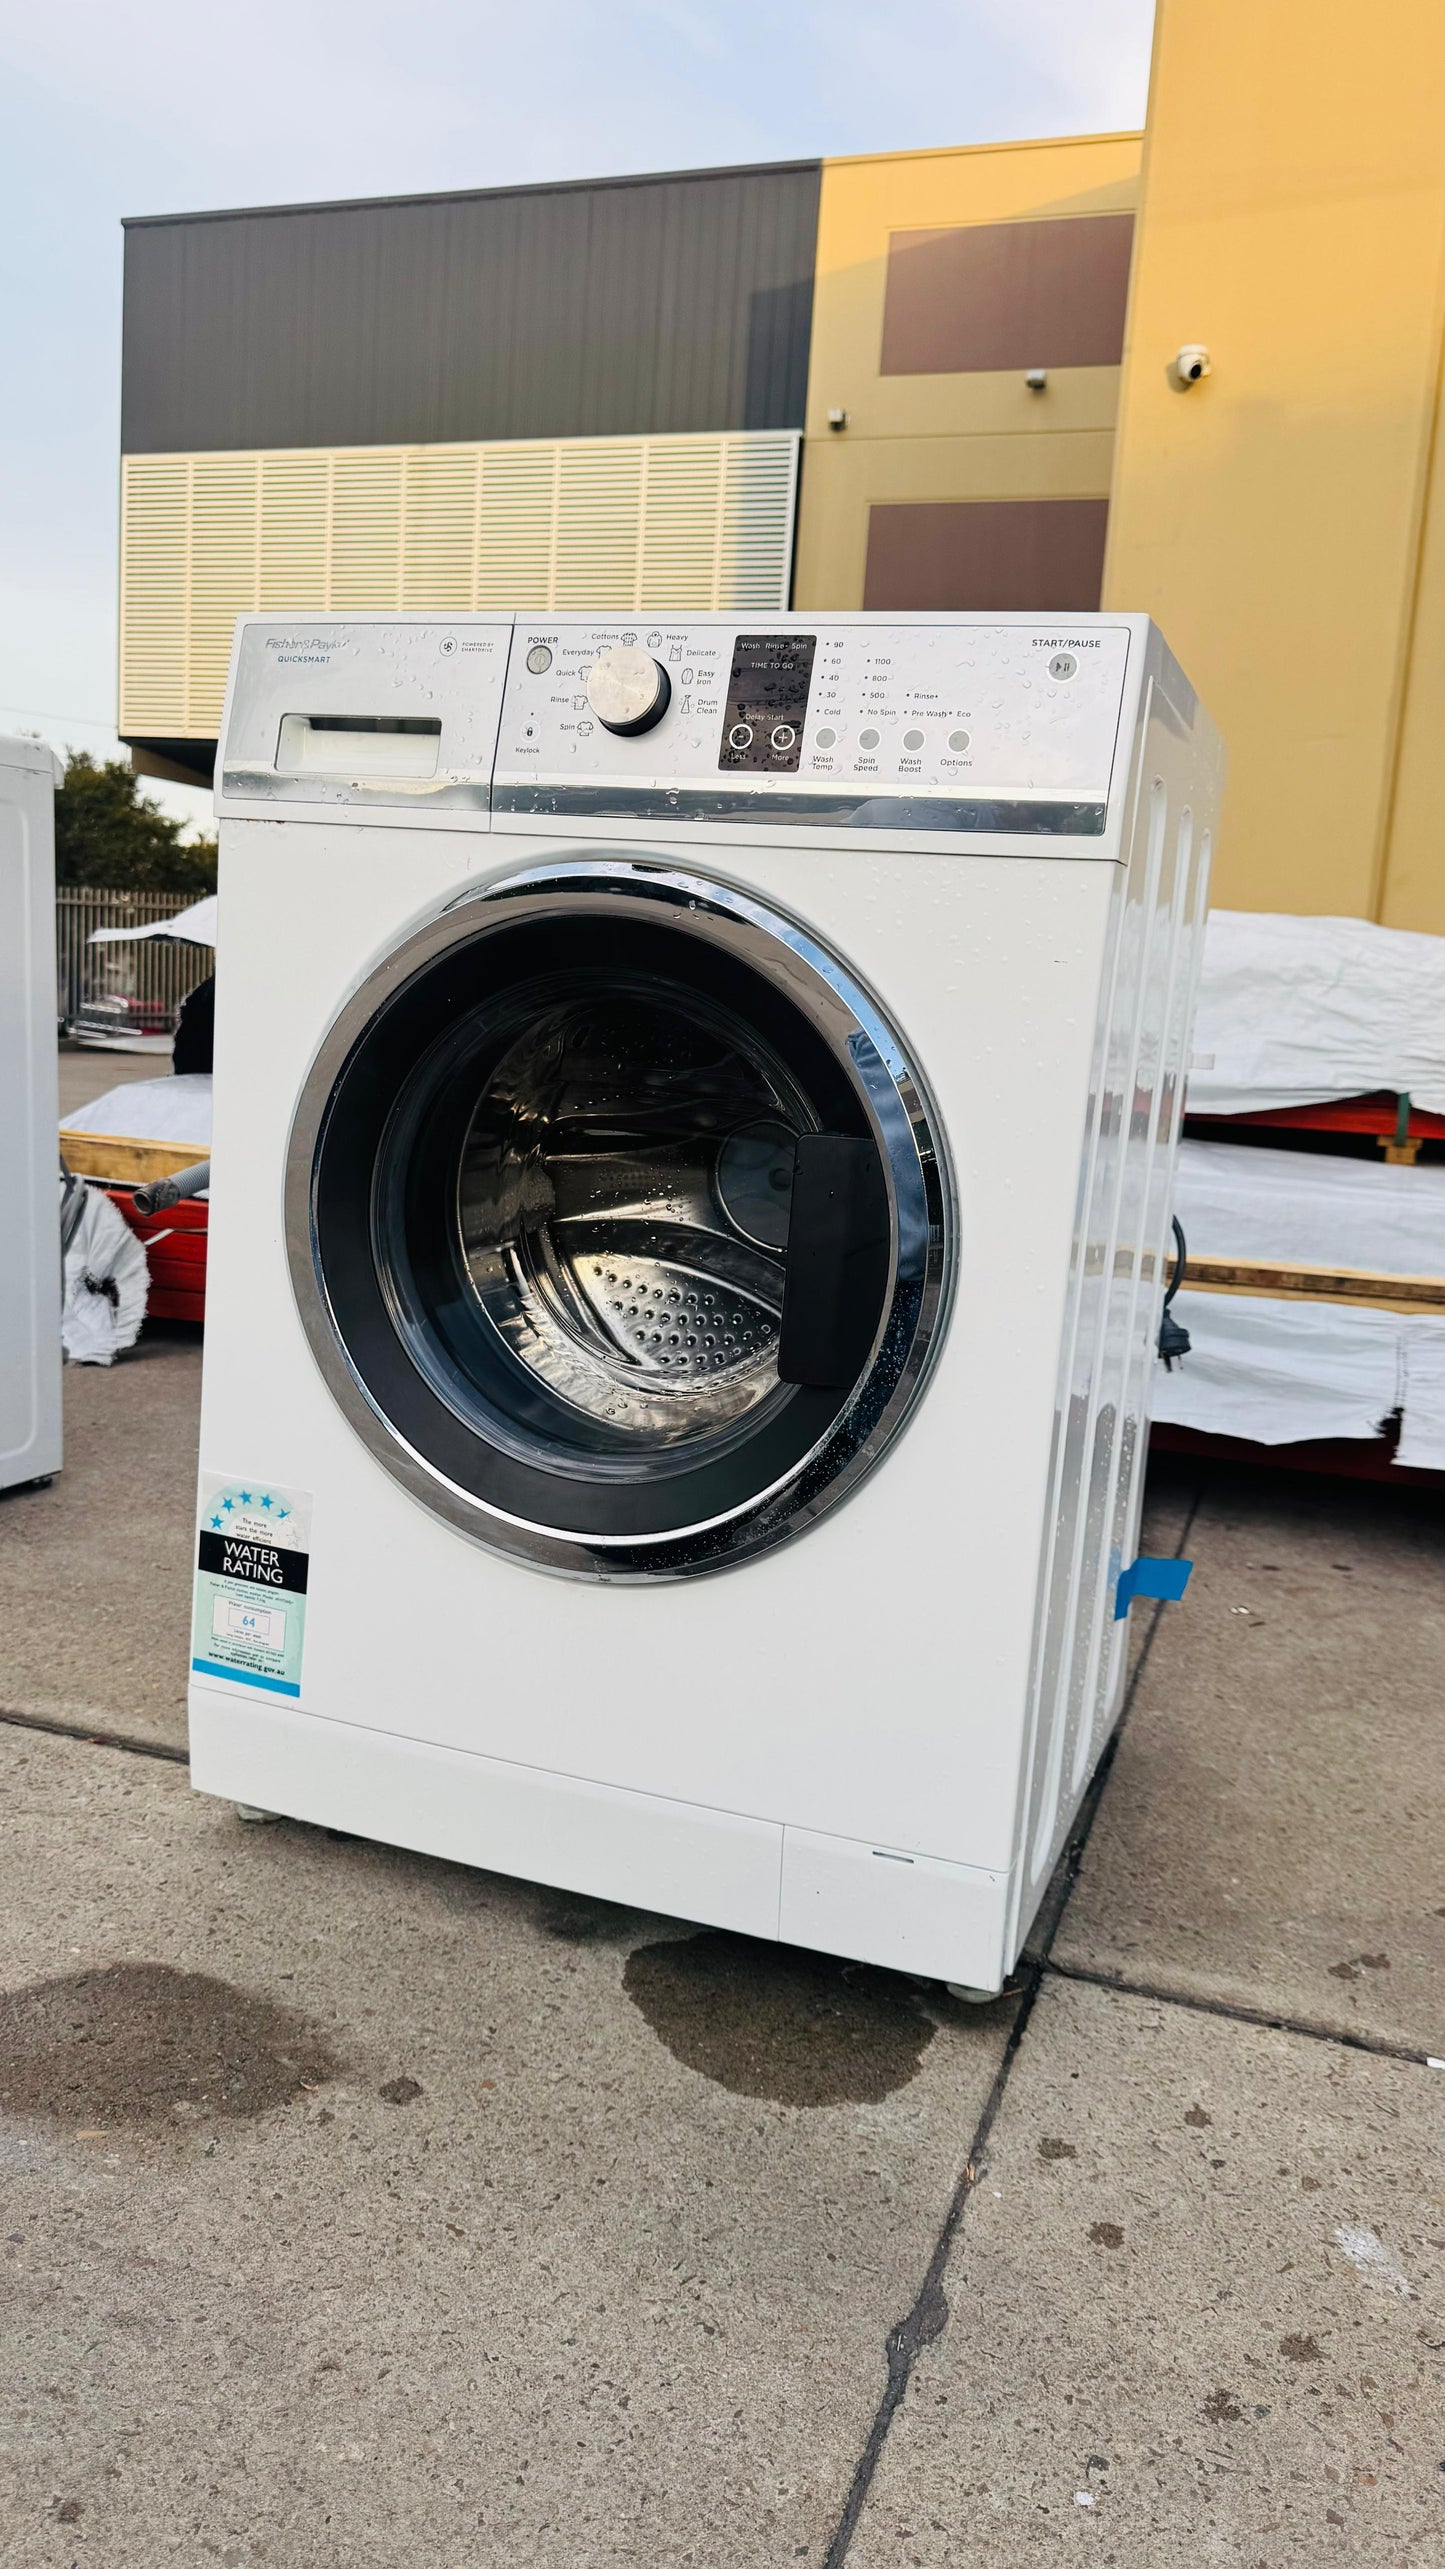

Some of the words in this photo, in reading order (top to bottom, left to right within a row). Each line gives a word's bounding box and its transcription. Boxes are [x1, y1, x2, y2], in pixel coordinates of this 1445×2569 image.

[527, 636, 558, 644] POWER
[666, 634, 688, 642] Heavy
[1032, 639, 1101, 648] START/PAUSE
[562, 648, 595, 657] Everyday
[686, 649, 717, 657] Delicate
[556, 669, 576, 677] Quick
[698, 670, 715, 678] Easy
[550, 696, 570, 704] Rinse
[696, 706, 718, 714] Clean
[880, 709, 896, 717] Spin
[745, 713, 766, 721] Delay
[560, 723, 576, 732] Spin
[858, 756, 876, 765] Spin
[900, 758, 922, 766] Wash
[940, 758, 973, 768] Options
[812, 764, 833, 772] Temp
[853, 764, 879, 772] Speed
[224, 1540, 280, 1567] WATER
[223, 1557, 283, 1584] RATING
[242, 1616, 256, 1628] 64
